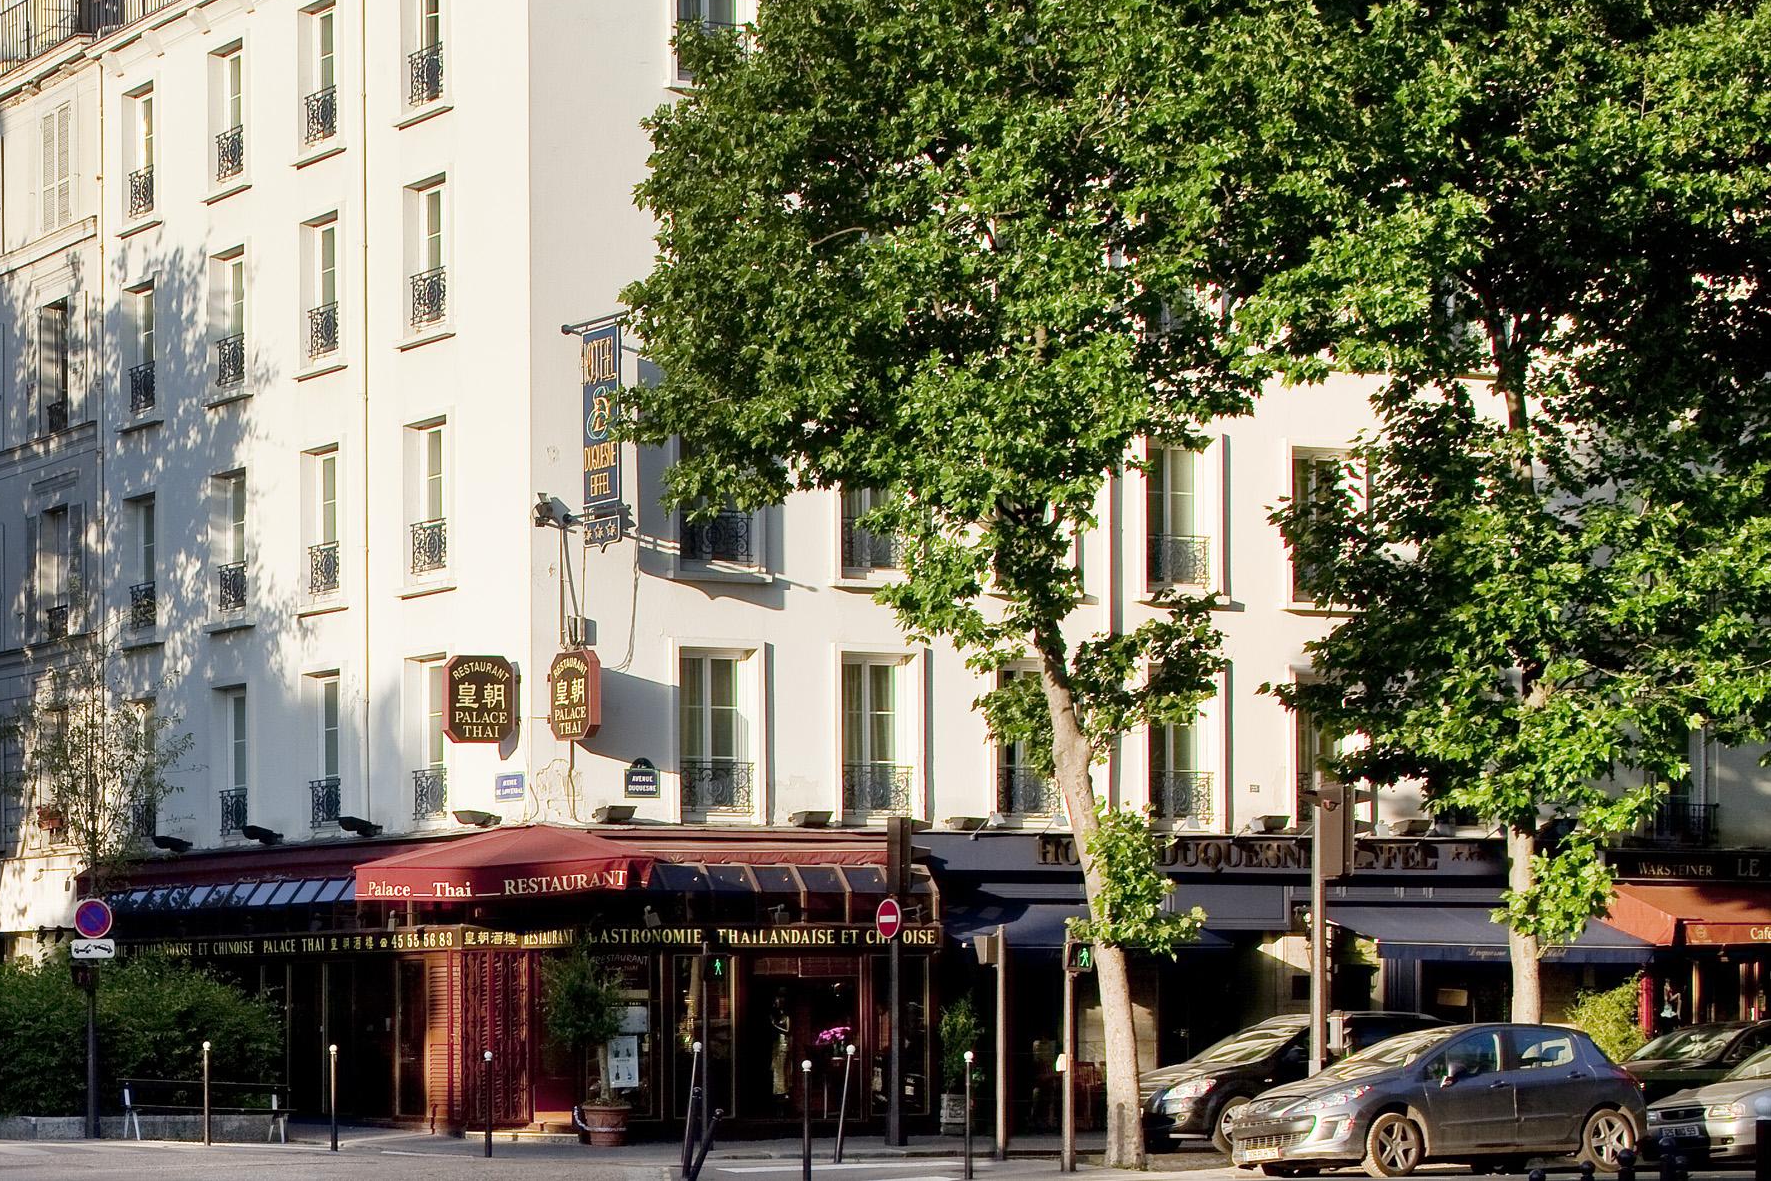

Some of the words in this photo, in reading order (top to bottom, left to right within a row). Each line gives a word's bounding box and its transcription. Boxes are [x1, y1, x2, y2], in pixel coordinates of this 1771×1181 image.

[584, 441, 616, 473] DUQUESNE
[590, 472, 611, 497] EIFFEL
[452, 661, 510, 681] RESTAURANT
[553, 657, 588, 679] RESTAURANT
[456, 681, 506, 709] 皇朝
[554, 677, 585, 706] 皇朝
[455, 711, 508, 724] PALACE
[554, 706, 587, 721] PALACE
[463, 725, 500, 738] THAI
[559, 722, 582, 735] THAI
[631, 775, 654, 783] AVENUE
[628, 784, 657, 793] DUQUESNE
[1737, 858, 1761, 877] LE
[367, 881, 411, 897] Palace
[432, 881, 473, 898] Thai
[503, 870, 627, 896] RESTAURANT
[391, 933, 403, 949] 45
[407, 932, 420, 948] 55
[423, 932, 436, 947] 56
[439, 931, 453, 946] 83
[524, 929, 574, 945] RESTAURANT
[841, 928, 860, 944] ET
[198, 942, 208, 956] ET
[213, 940, 254, 955] CHINOISE
[263, 938, 296, 953] PALACE
[301, 937, 325, 952] THAI
